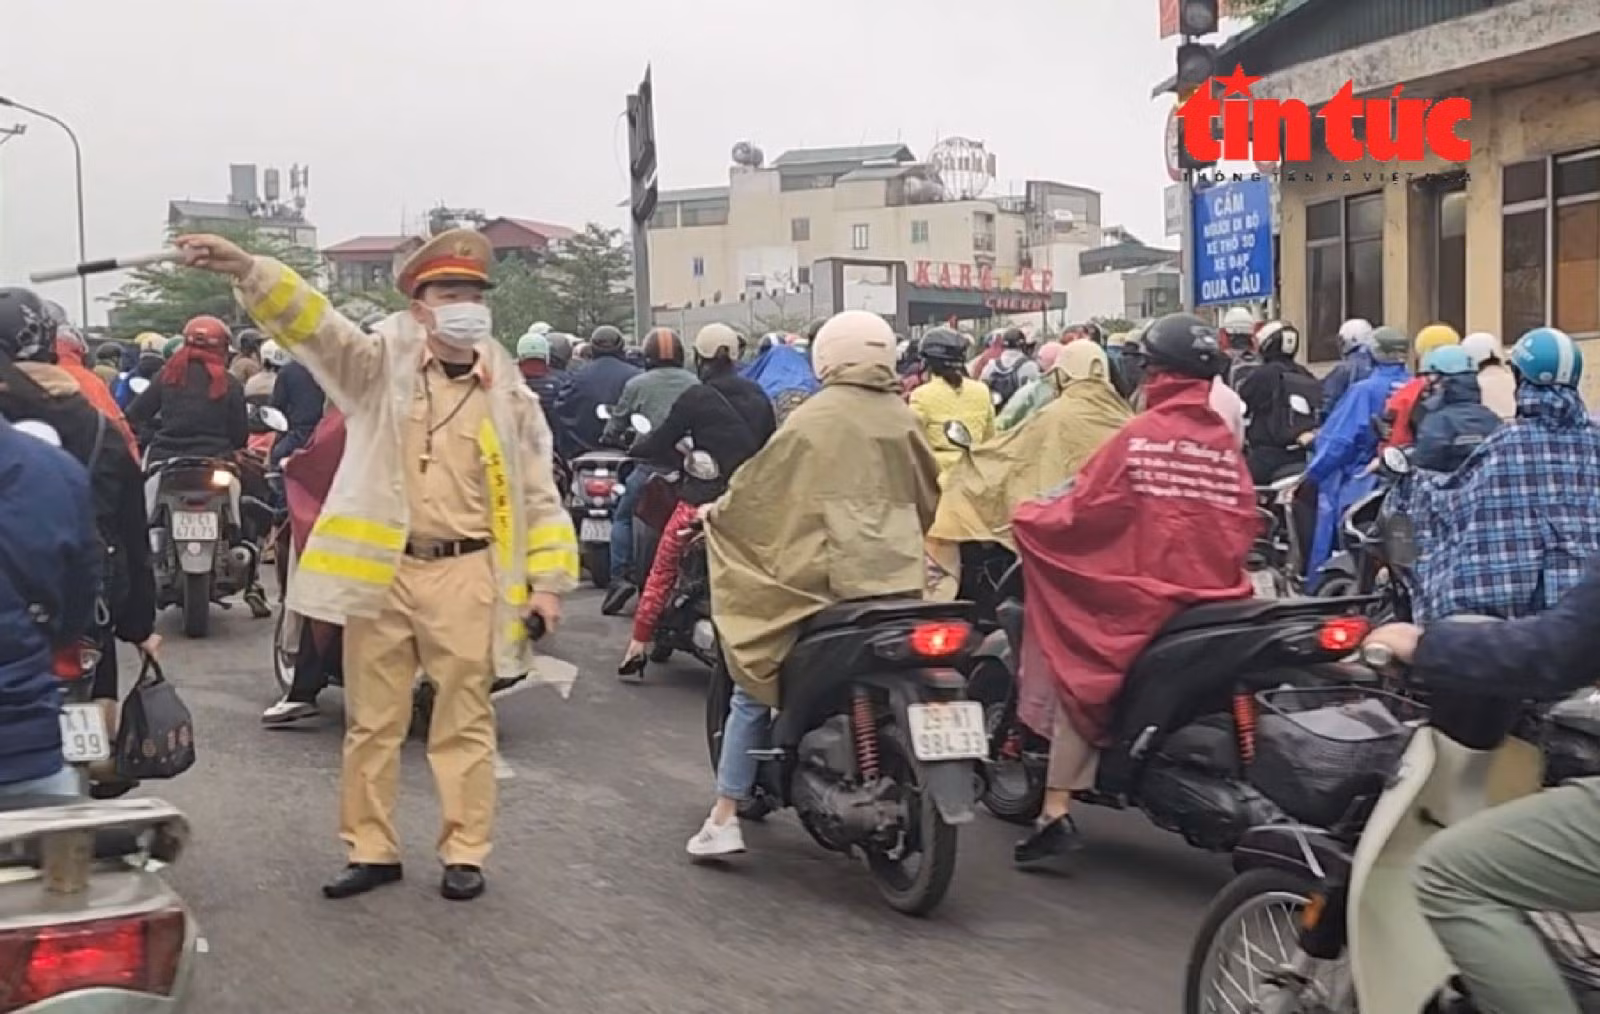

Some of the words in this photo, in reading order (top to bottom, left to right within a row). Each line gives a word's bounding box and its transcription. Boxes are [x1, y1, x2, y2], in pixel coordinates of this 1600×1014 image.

[1213, 187, 1244, 217] CẤM
[1213, 256, 1227, 272] XE
[1202, 278, 1229, 301] QUA
[1231, 265, 1260, 297] CẦU
